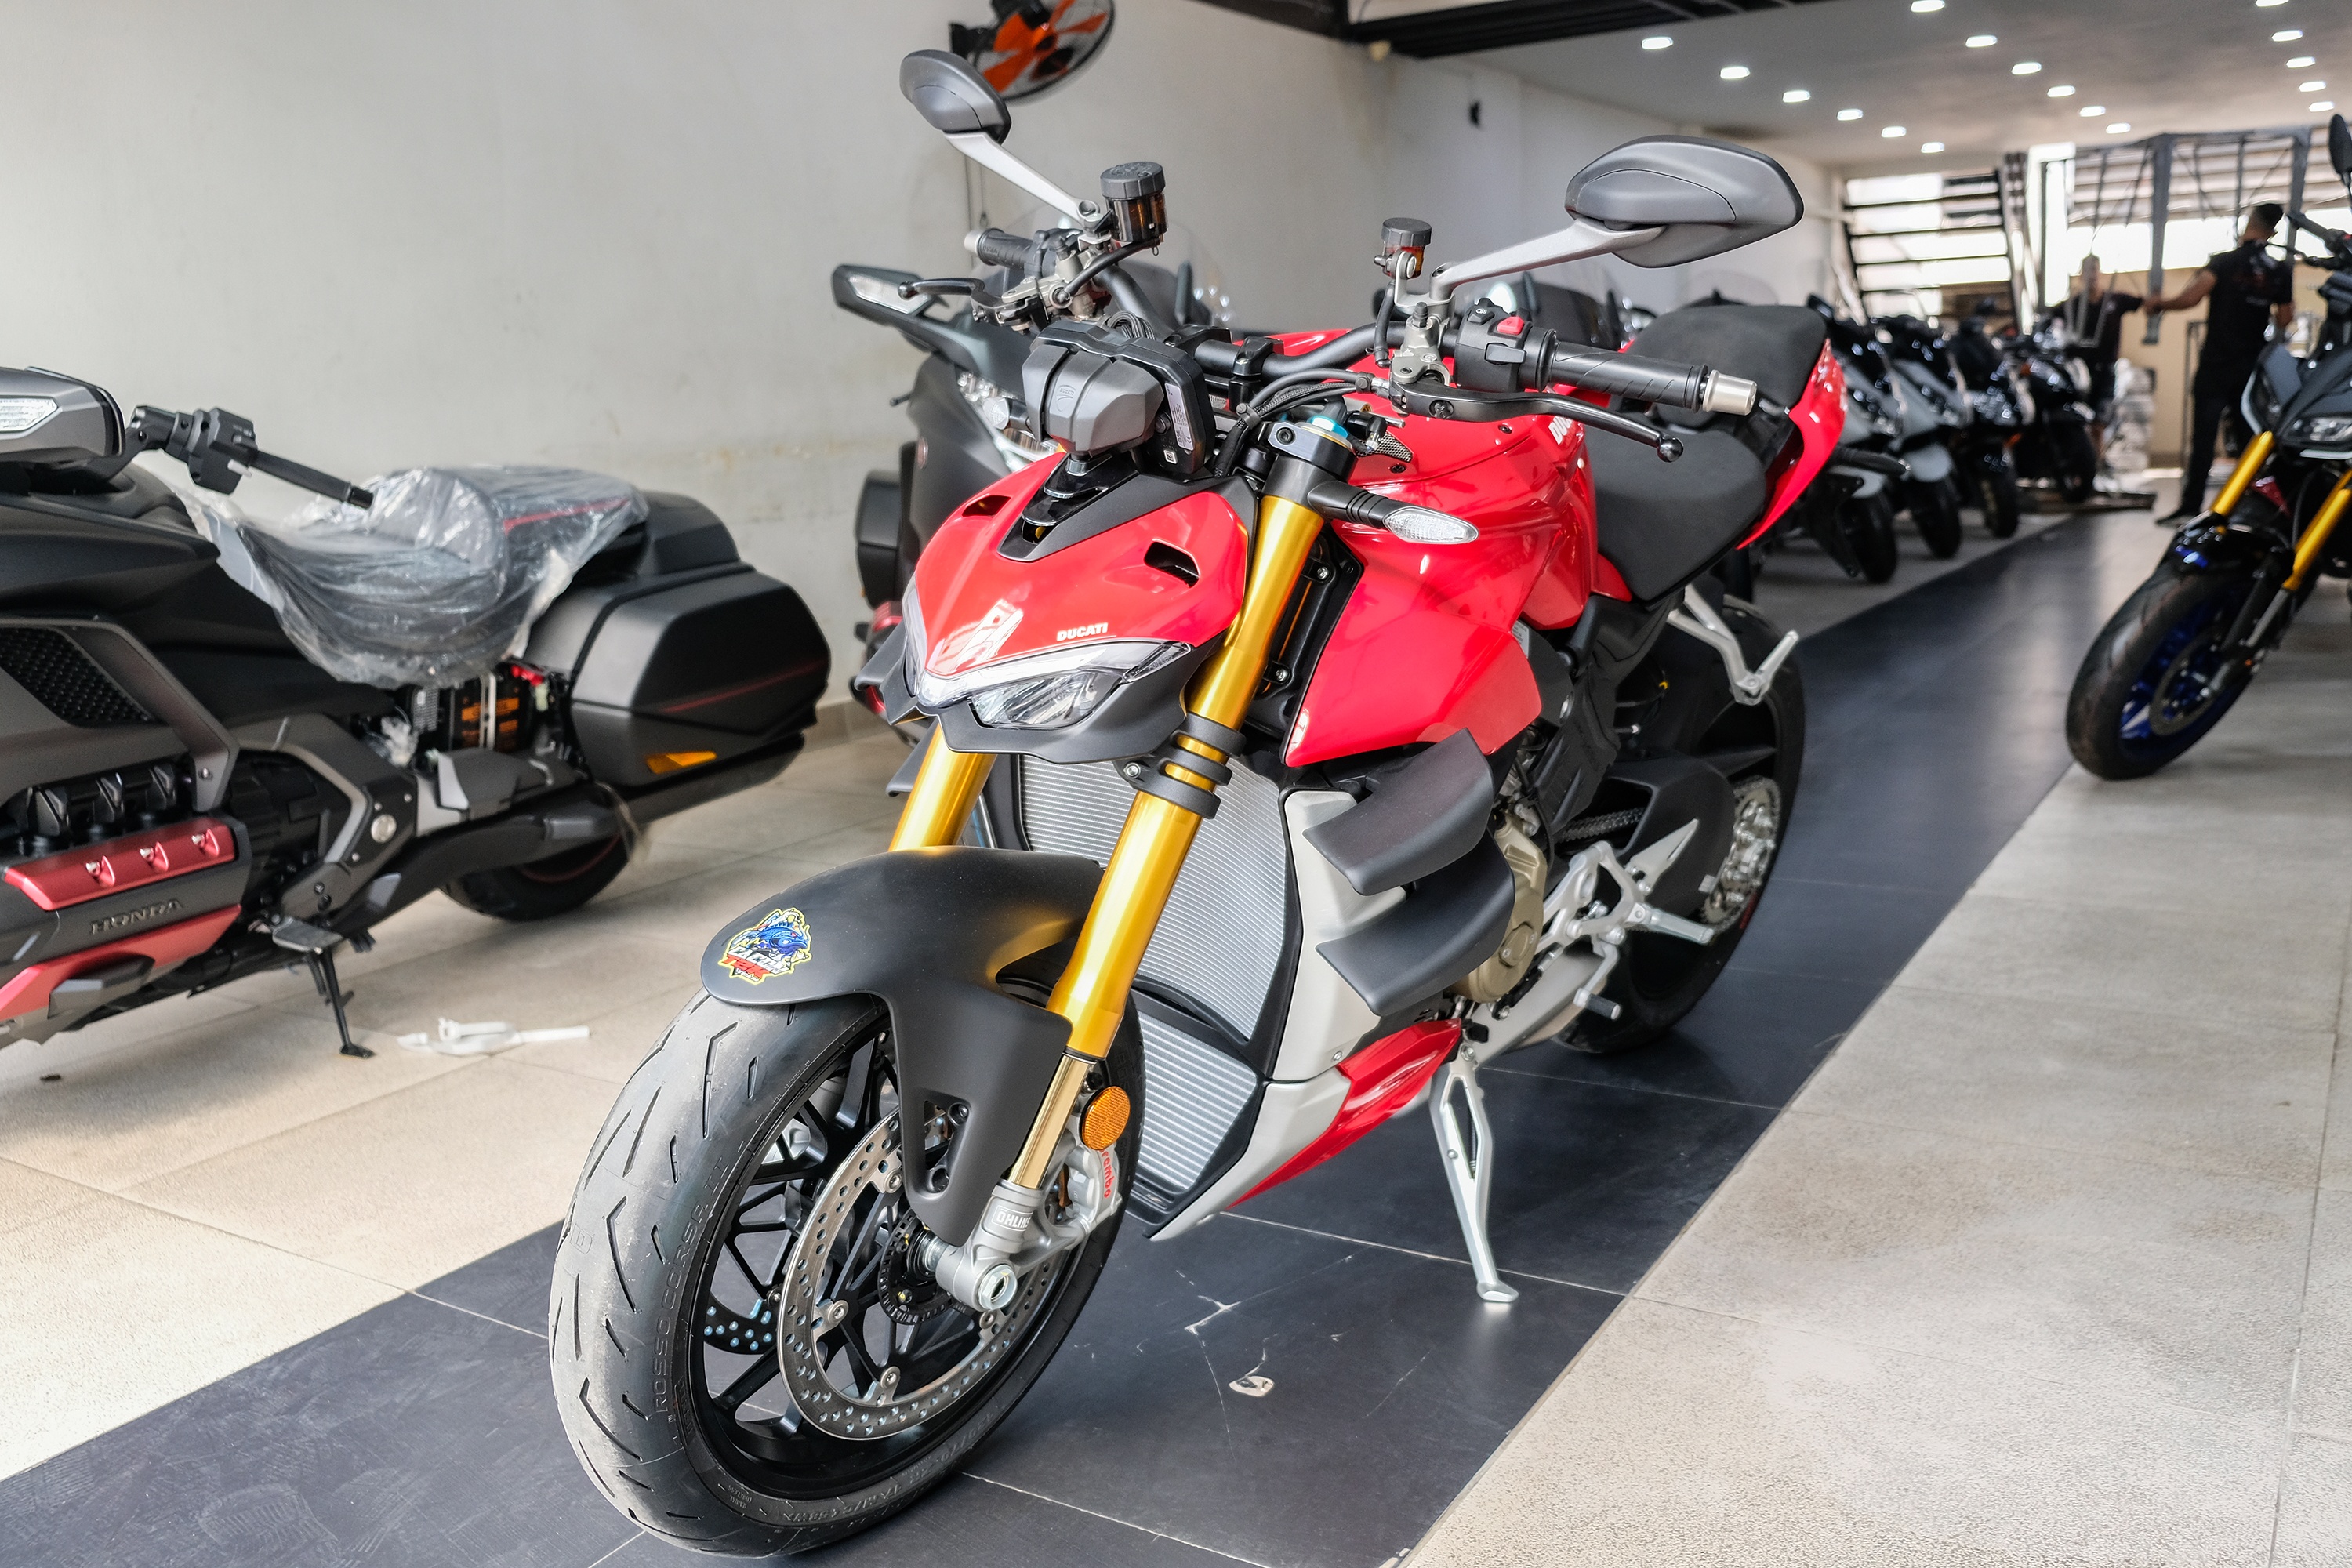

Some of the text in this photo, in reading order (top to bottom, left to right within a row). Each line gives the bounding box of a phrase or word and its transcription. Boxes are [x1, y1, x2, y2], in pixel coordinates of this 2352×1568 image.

[1056, 622, 1109, 642] DUCATI
[90, 898, 183, 935] HONDA
[1099, 1149, 1115, 1199] rembo
[652, 1155, 730, 1413] ROSSO CORSA II
